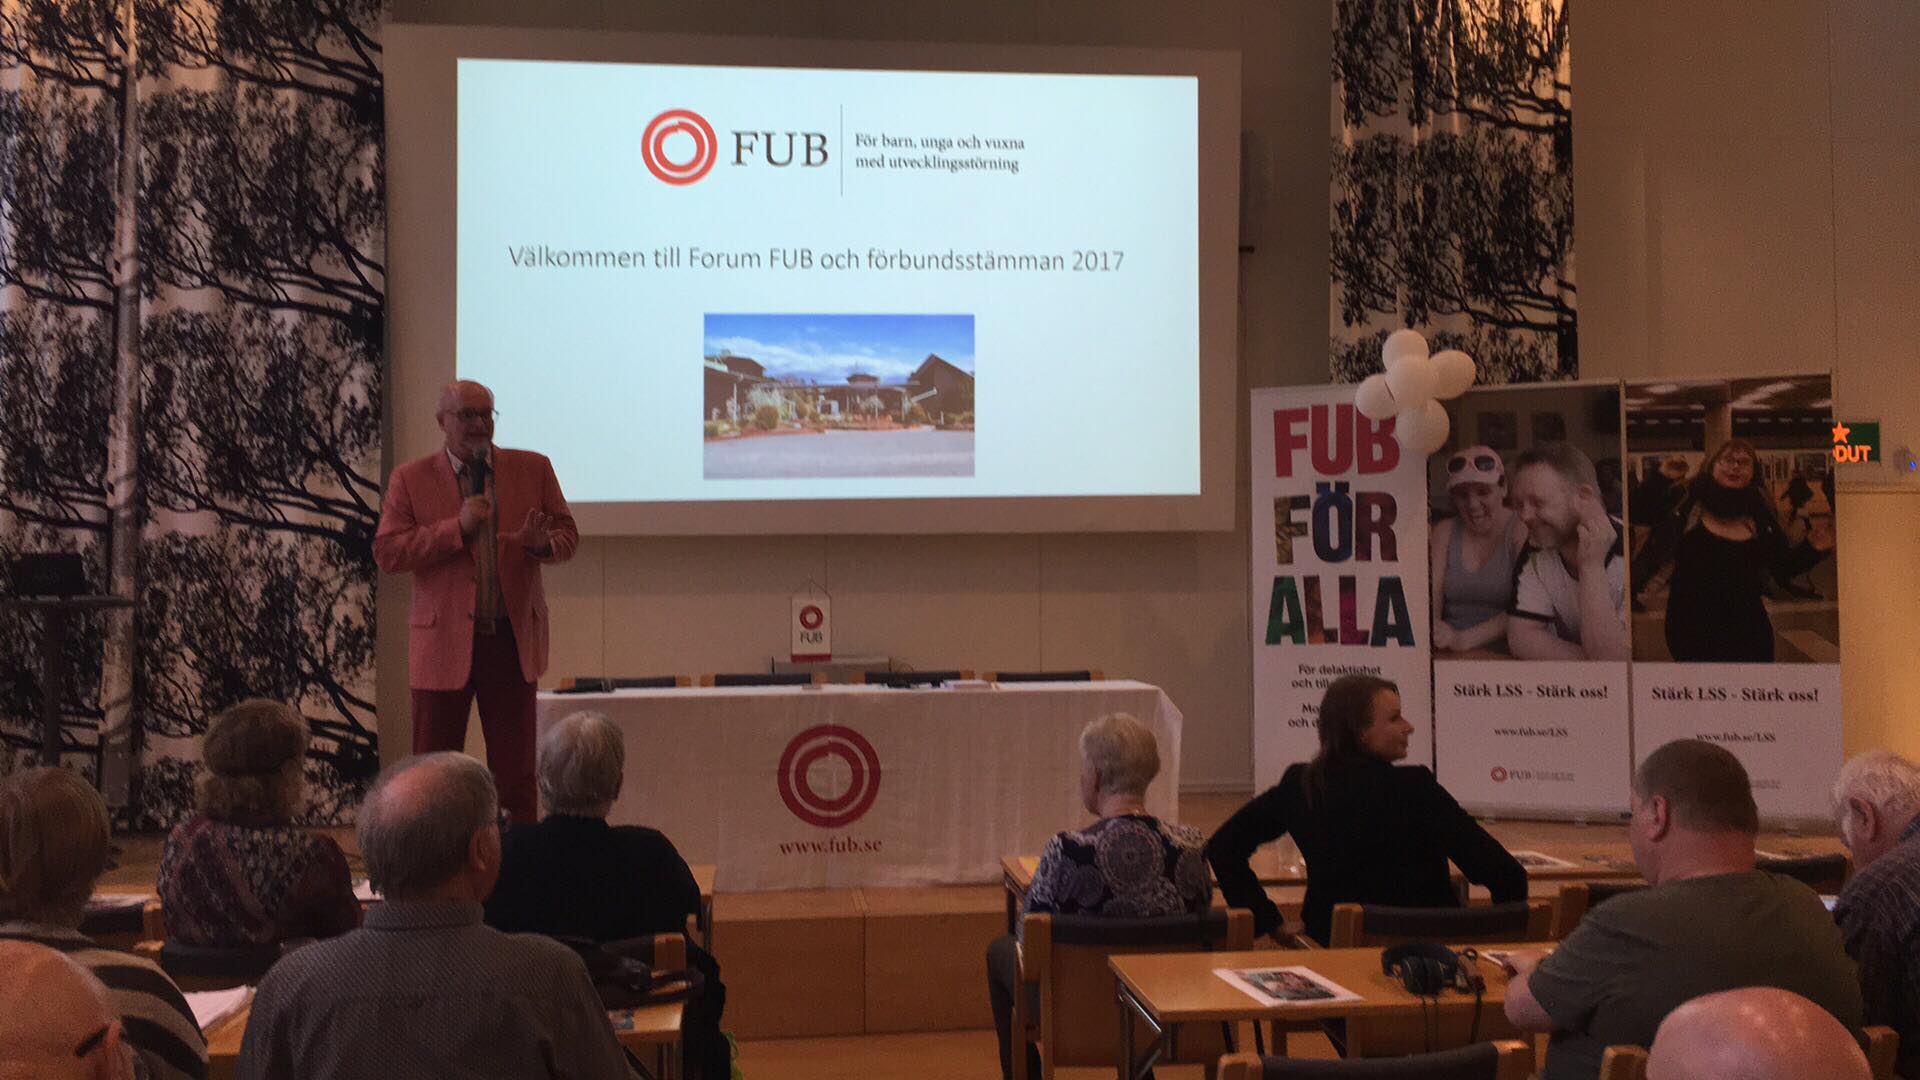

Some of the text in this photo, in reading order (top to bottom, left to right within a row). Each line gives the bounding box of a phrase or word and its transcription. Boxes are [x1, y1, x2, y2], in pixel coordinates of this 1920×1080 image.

[730, 130, 829, 167] FUB
[855, 133, 1025, 152] För barn, unga och vuxna
[855, 154, 1019, 174] med utvecklingsstörning
[508, 245, 1125, 272] Välkommen till Forum FUB och förbundsstämman 2017
[1273, 403, 1401, 478] FUB
[1273, 482, 1399, 566] FÖR
[1265, 575, 1416, 648] ALLA
[800, 632, 823, 644] FUB
[1298, 664, 1315, 675] För
[1291, 679, 1312, 688] och
[1453, 684, 1491, 697] Stärk
[1496, 685, 1523, 697] LSS
[1536, 685, 1576, 698] Stärk
[1579, 686, 1608, 699] oss!
[1652, 687, 1693, 700] Stärk
[1698, 688, 1727, 700] LSS
[1741, 688, 1784, 701] Stärk
[1788, 688, 1818, 702] oss!
[1288, 718, 1309, 728] och
[1494, 727, 1568, 737] www.fub.se/LSS
[780, 836, 882, 855] www.fub.se
